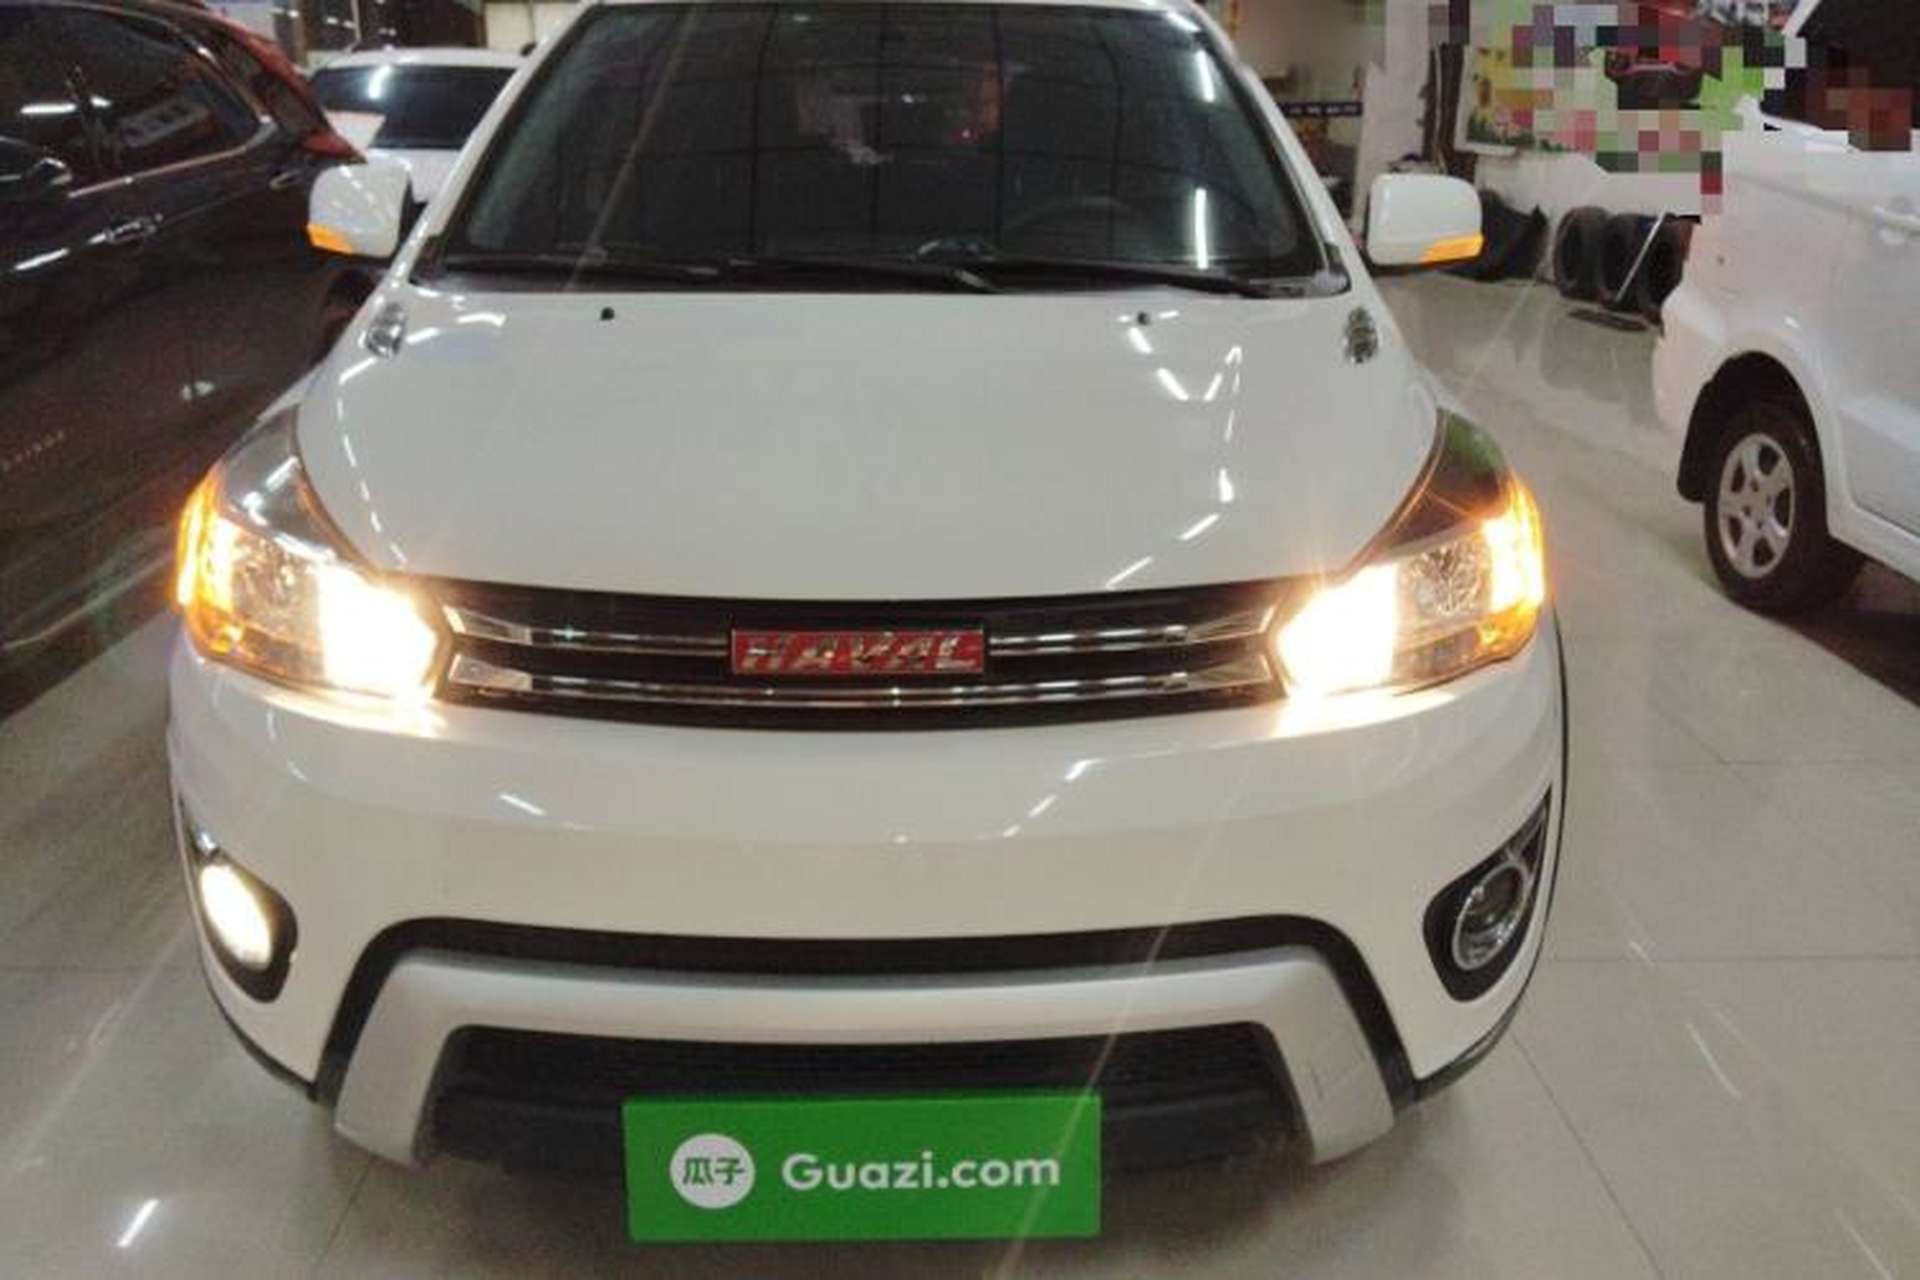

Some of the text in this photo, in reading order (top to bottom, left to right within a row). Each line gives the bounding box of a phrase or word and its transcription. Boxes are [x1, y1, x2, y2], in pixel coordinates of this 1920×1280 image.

[741, 633, 976, 673] HAVAL
[682, 1156, 745, 1186] 瓜子
[782, 1151, 1059, 1190] Guazi.com
